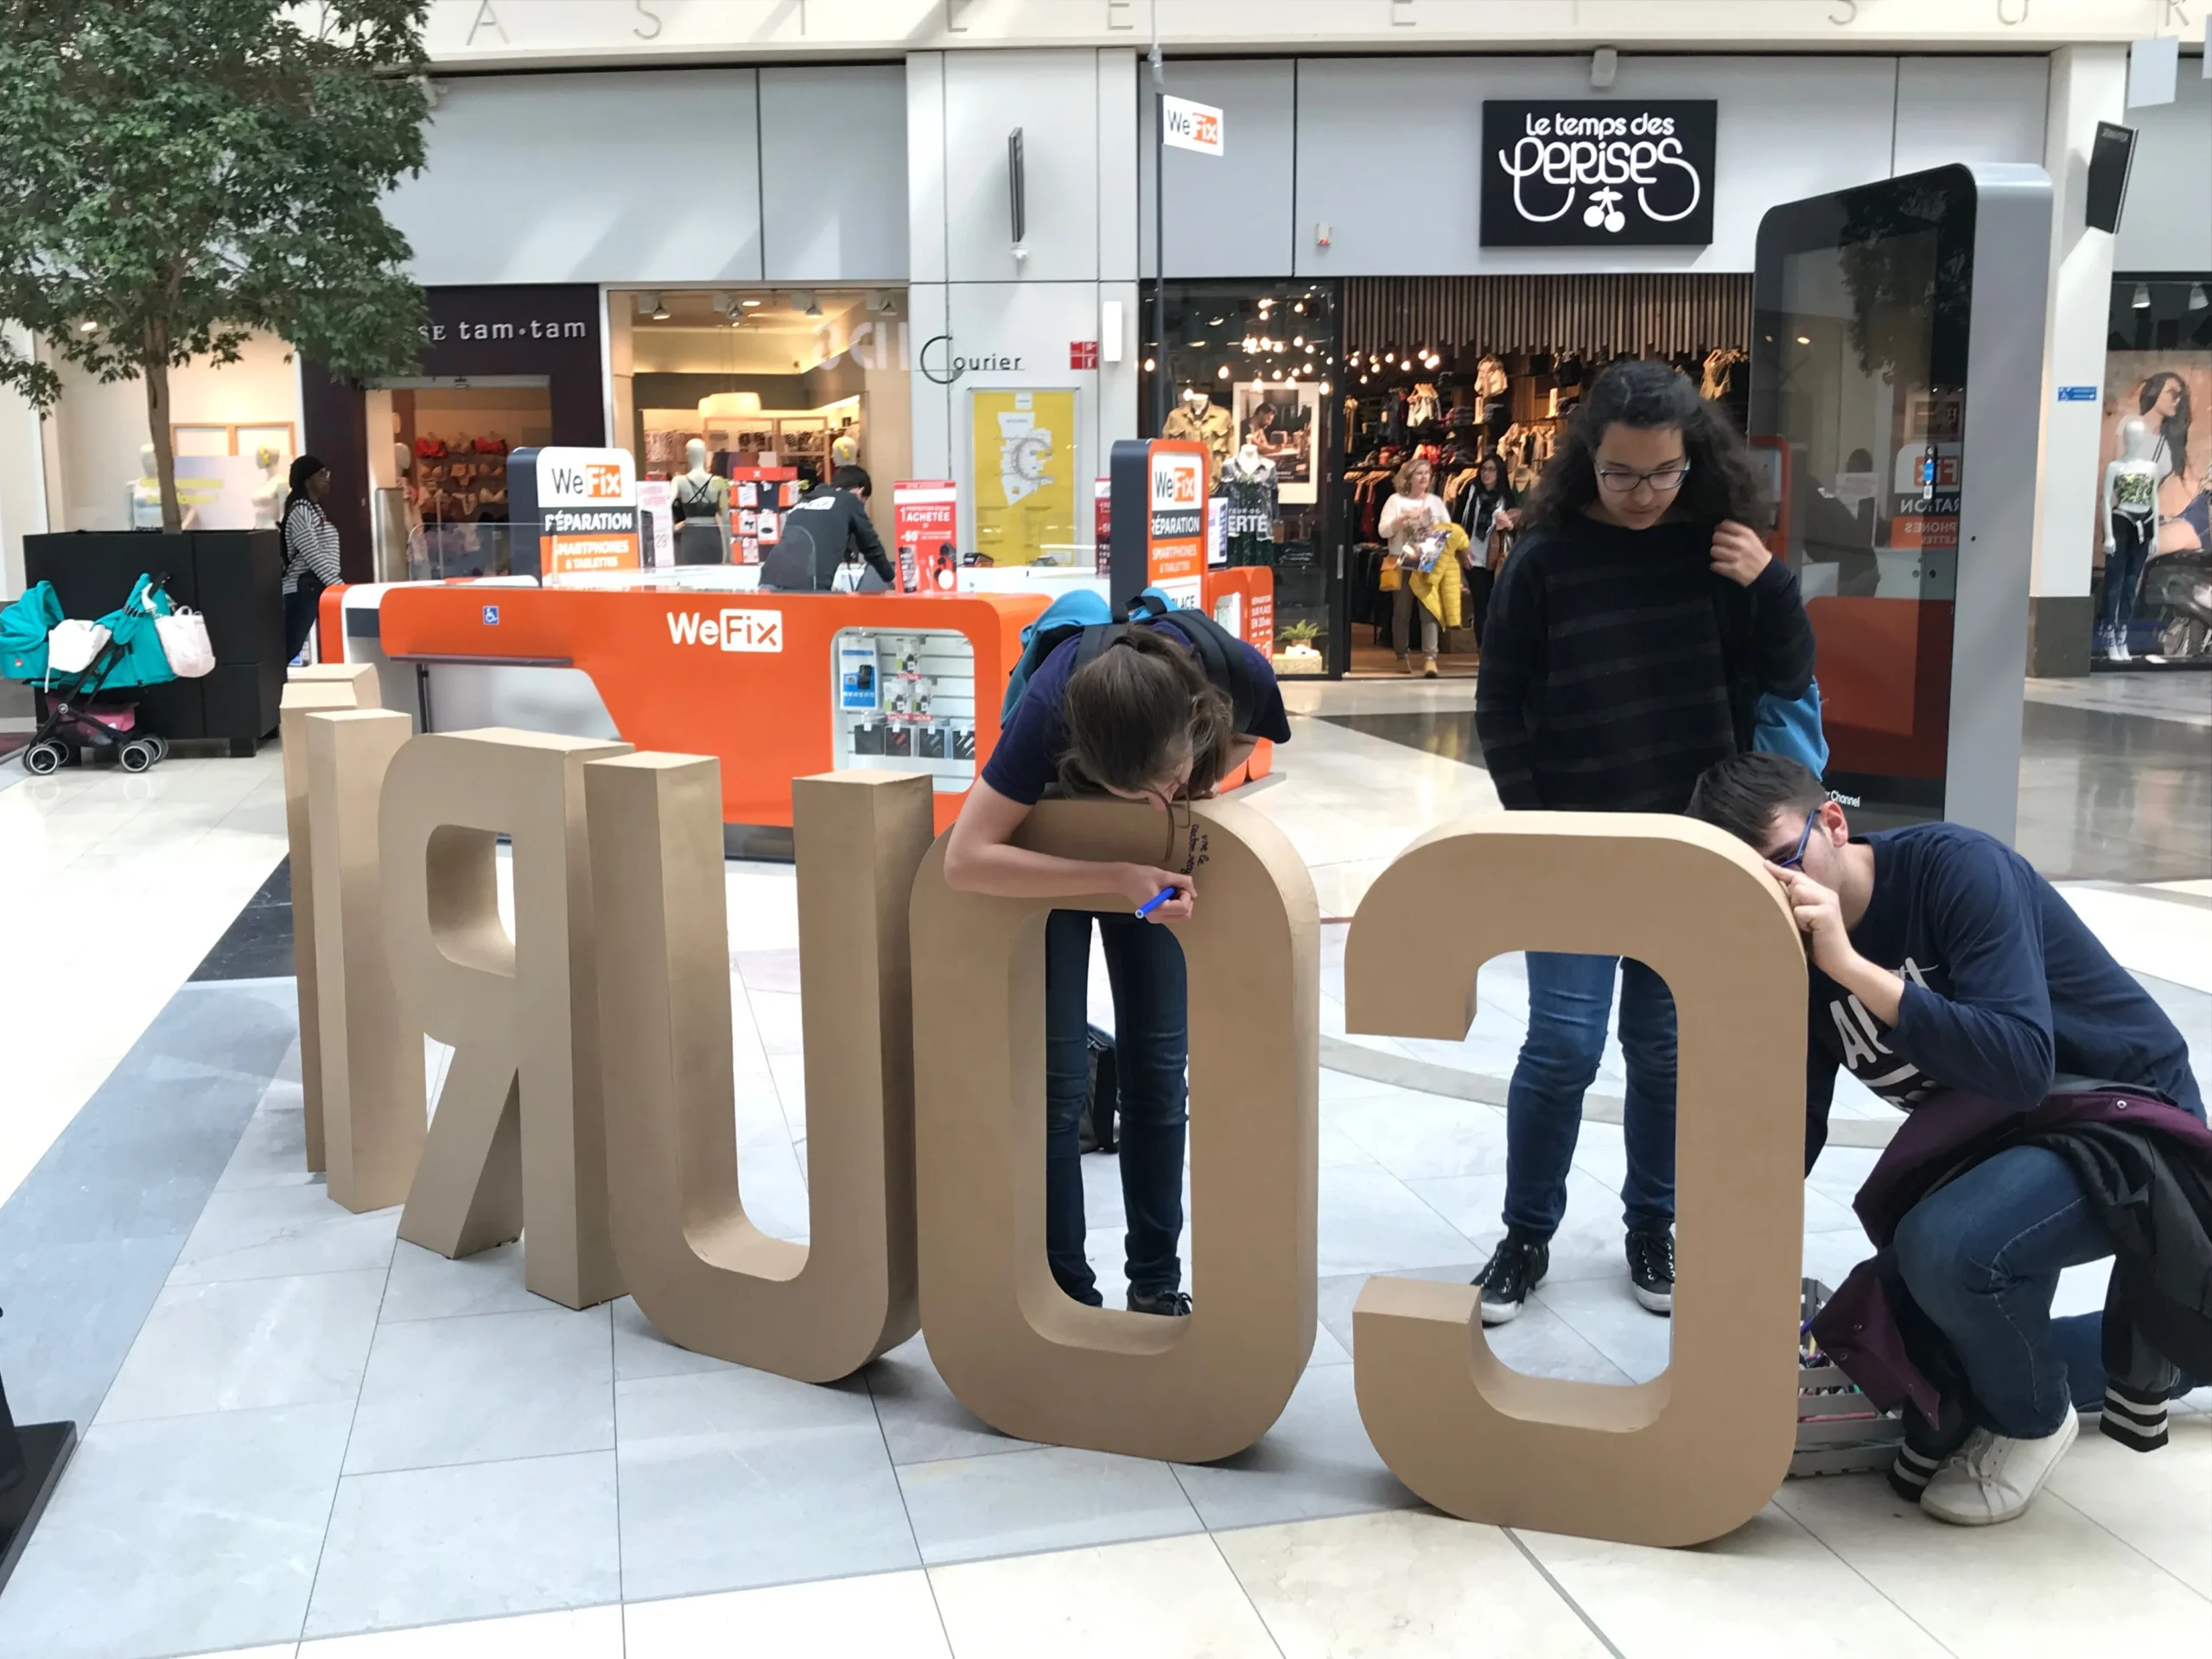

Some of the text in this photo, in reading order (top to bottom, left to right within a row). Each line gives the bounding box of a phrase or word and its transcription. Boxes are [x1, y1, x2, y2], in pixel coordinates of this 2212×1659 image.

[1167, 109, 1217, 144] WeFix
[1555, 112, 1627, 140] temps
[1630, 112, 1675, 136] des
[920, 335, 1022, 385] Courier
[551, 465, 621, 497] WeFix
[1155, 467, 1194, 501] WeFix
[906, 512, 950, 522] ACHETÉE
[1151, 514, 1200, 536] RÉPARATION
[1228, 513, 1268, 532] ERTÉ
[666, 609, 782, 652] WeFix
[1831, 790, 1860, 807] Channel
